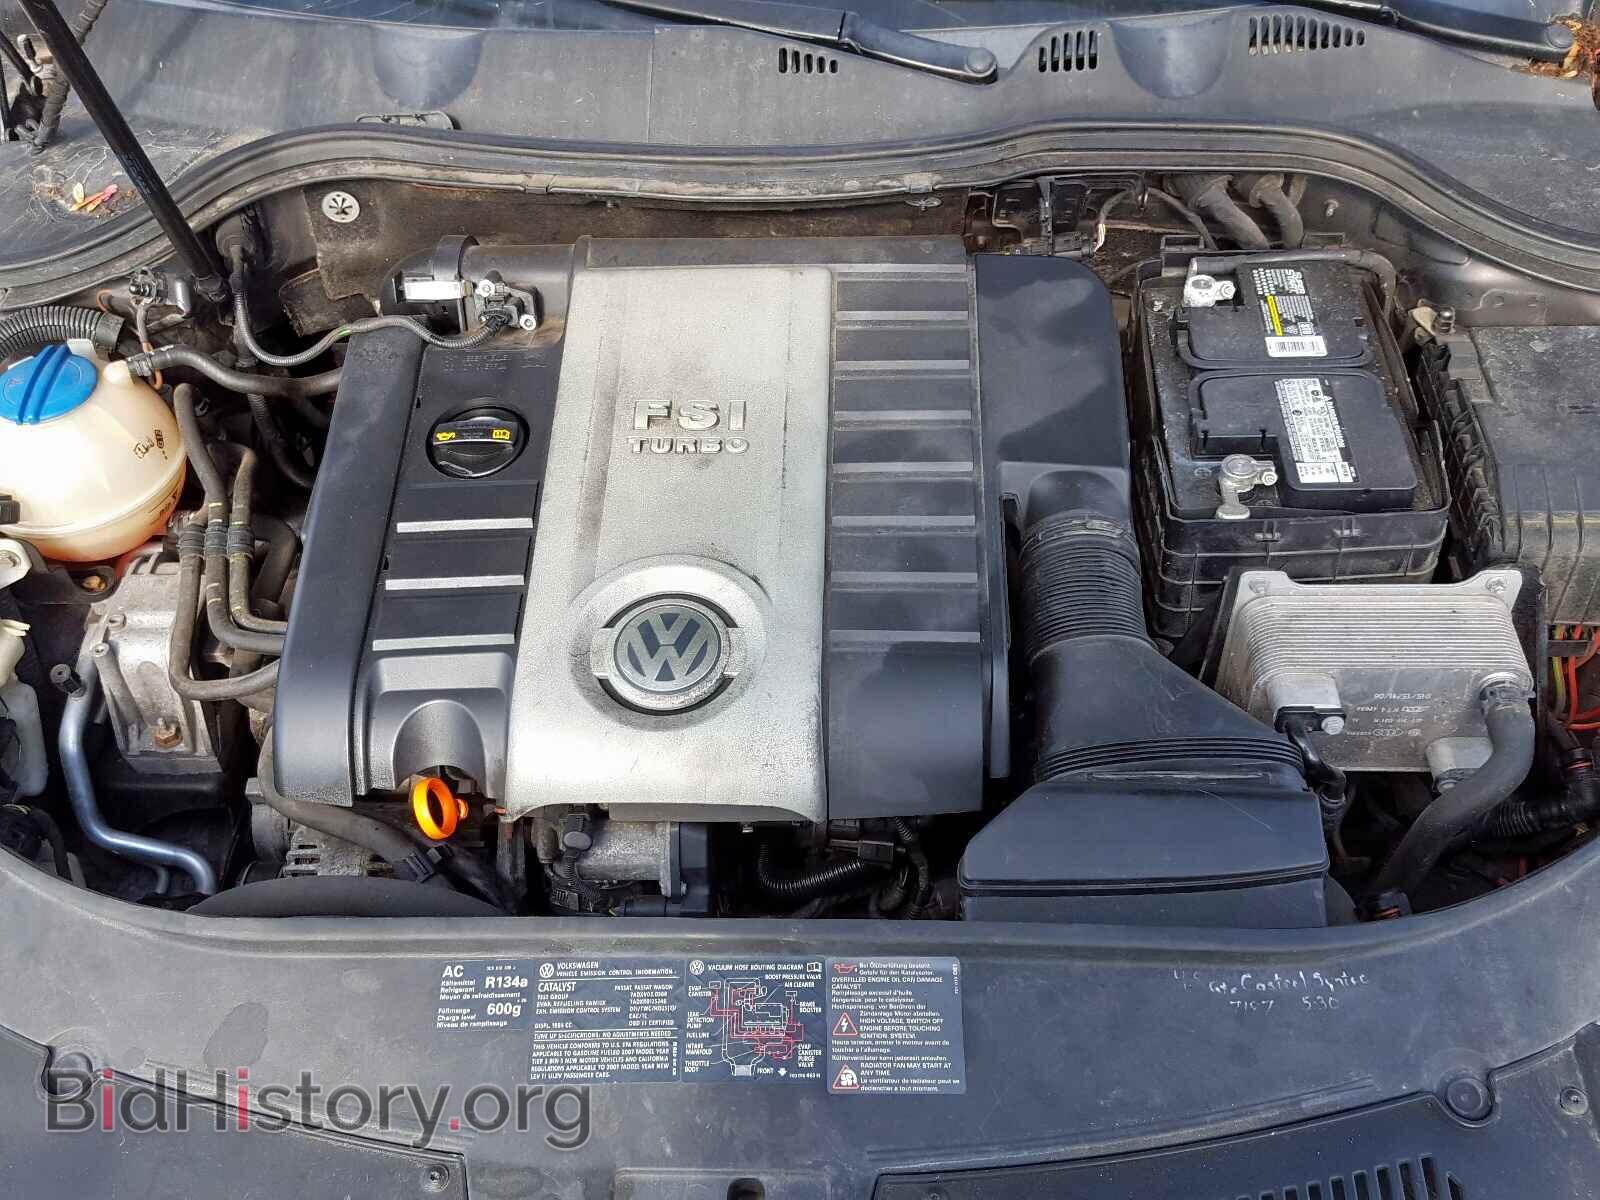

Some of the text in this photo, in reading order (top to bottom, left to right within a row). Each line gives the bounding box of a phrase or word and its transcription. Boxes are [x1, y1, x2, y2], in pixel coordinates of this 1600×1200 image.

[633, 400, 747, 431] FSI
[627, 437, 749, 454] TURBO
[442, 965, 464, 977] AC
[557, 961, 599, 969] VOLKSWAGEN
[485, 976, 528, 988] R134a
[538, 982, 576, 992] CATALYST
[487, 1003, 521, 1017] 600g
